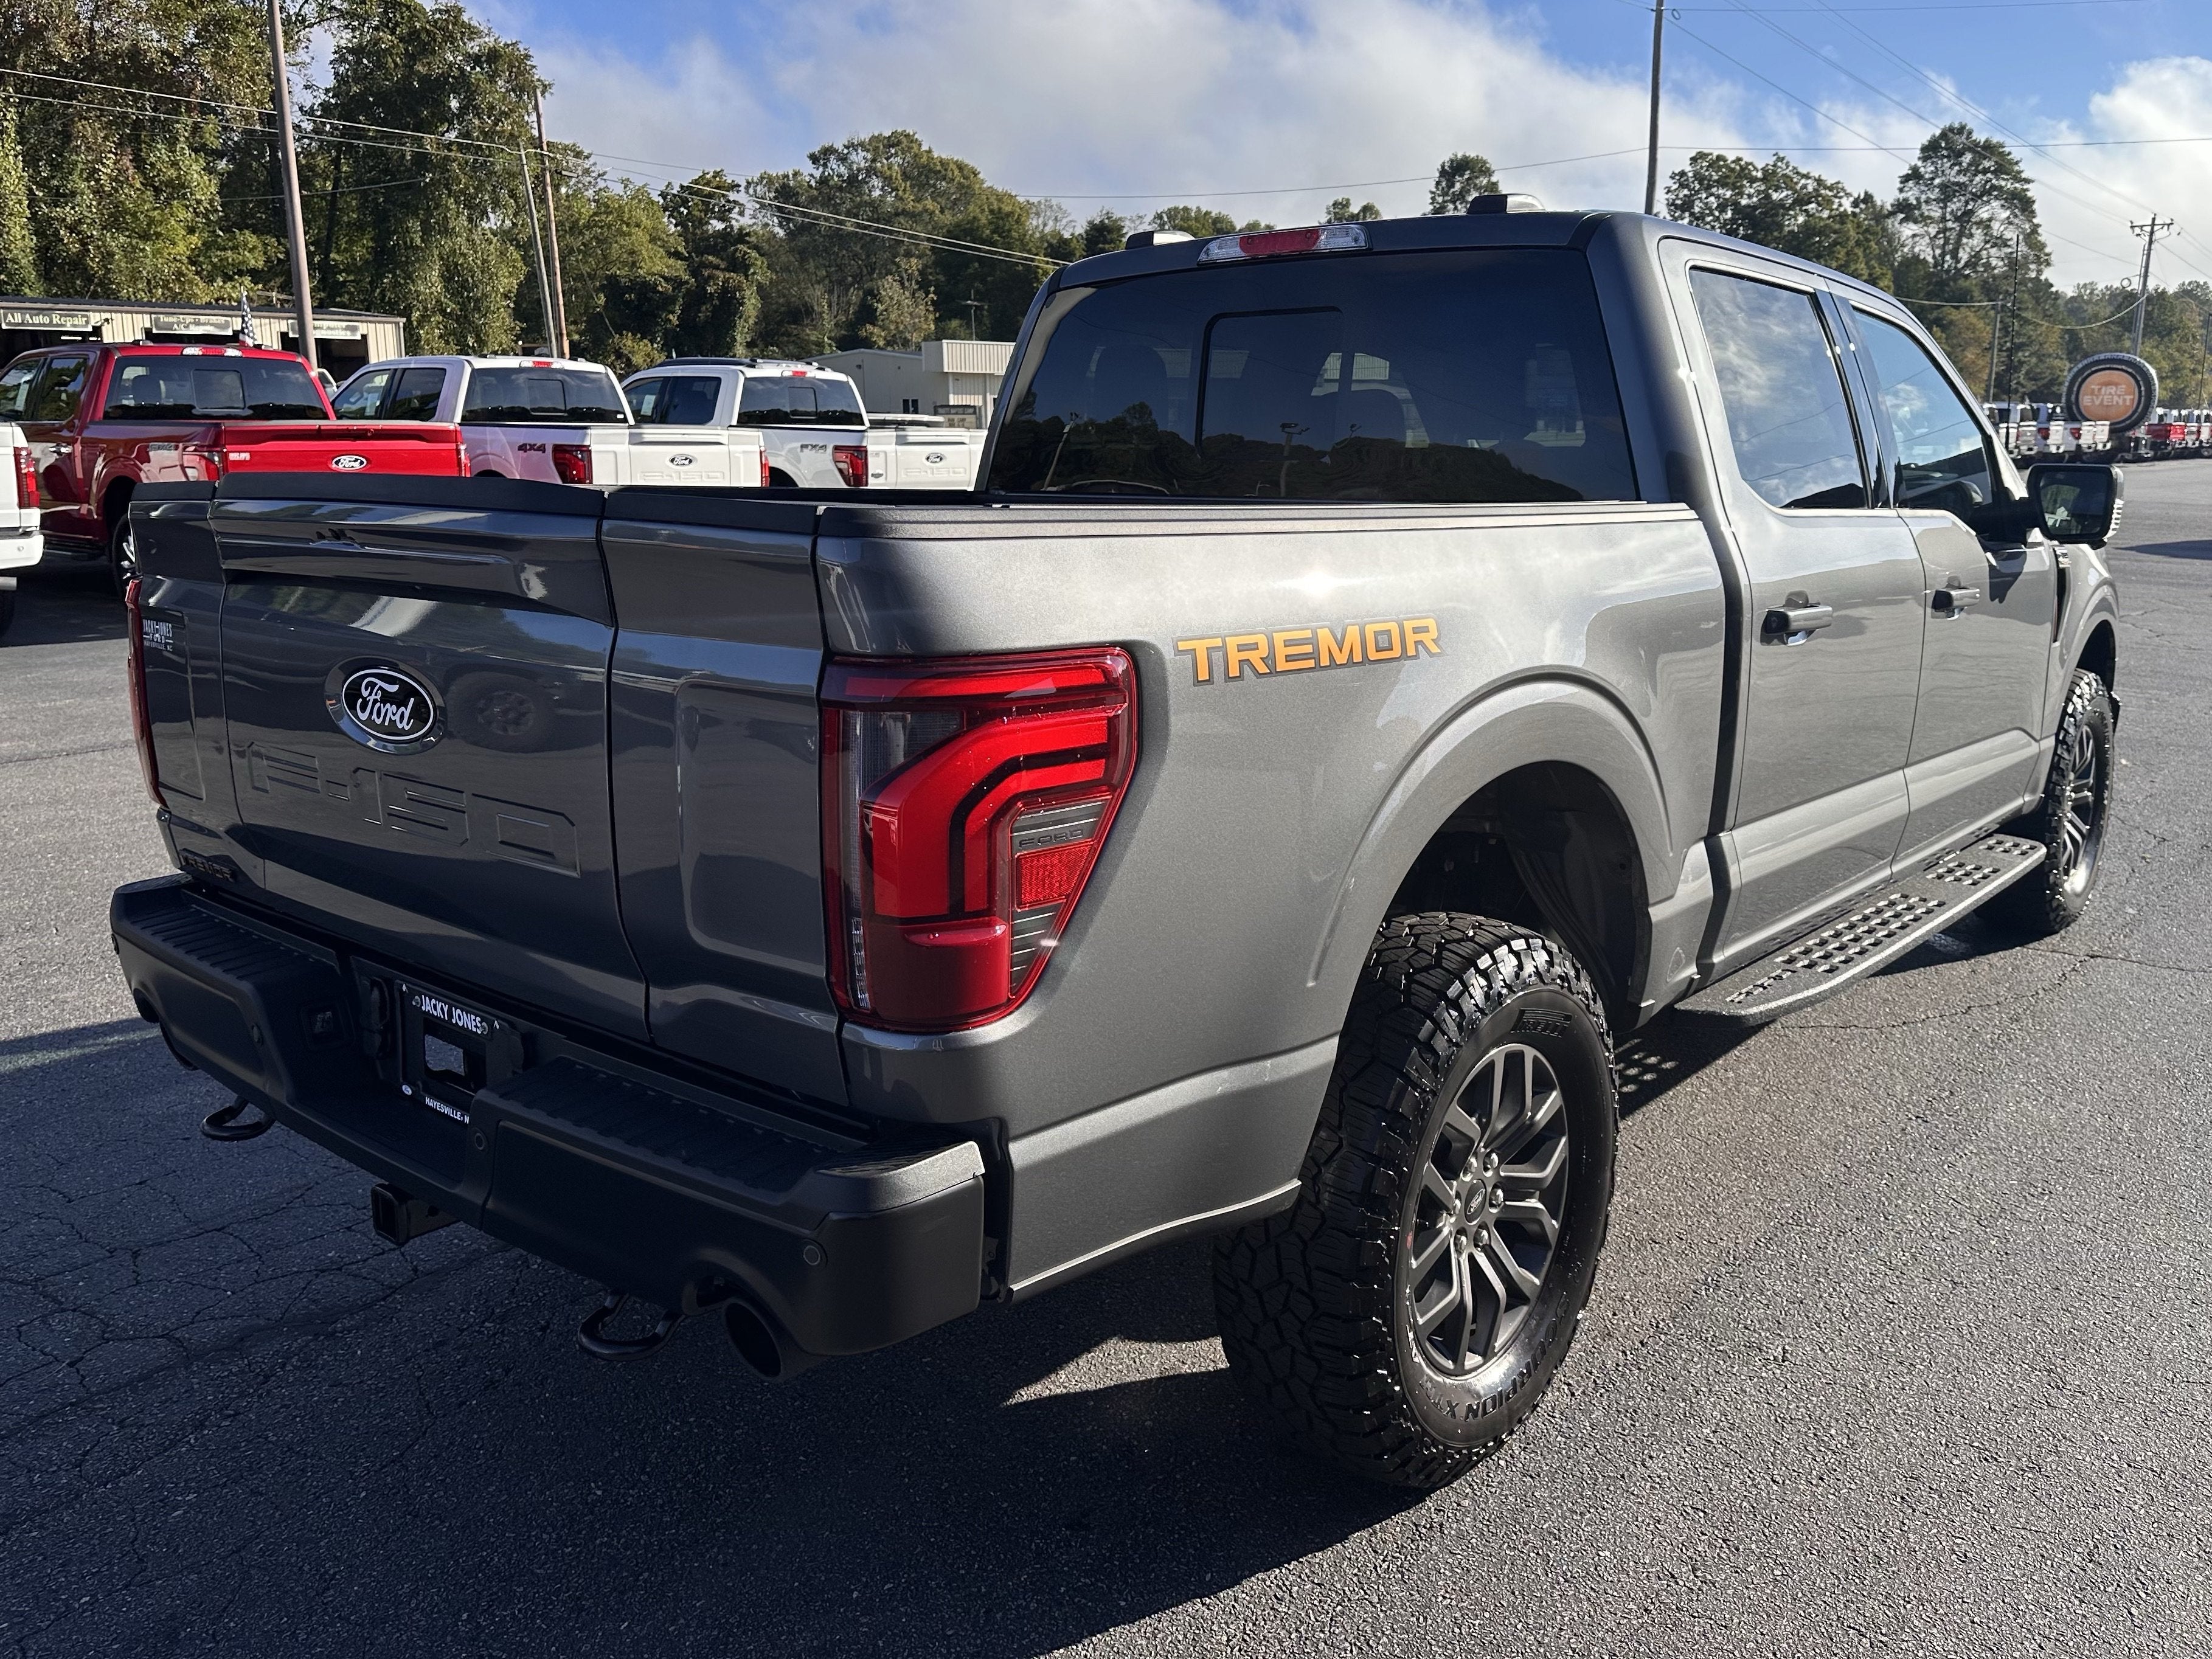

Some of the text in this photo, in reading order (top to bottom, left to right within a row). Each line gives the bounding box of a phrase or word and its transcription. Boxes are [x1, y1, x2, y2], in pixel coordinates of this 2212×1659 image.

[5, 313, 88, 327] All Auto Repair
[2090, 385, 2126, 395] TIRE
[2082, 395, 2134, 406] EVENT
[799, 443, 828, 453] FX4
[338, 457, 361, 468] Ford
[637, 471, 725, 482] F-150
[903, 468, 967, 477] F-150
[150, 633, 165, 643] FORD
[1175, 617, 1443, 683] TREMOR
[356, 676, 415, 730] Ford
[248, 741, 581, 878] F-150
[1018, 829, 1083, 848] FORD
[421, 994, 482, 1034] JACKY JONES
